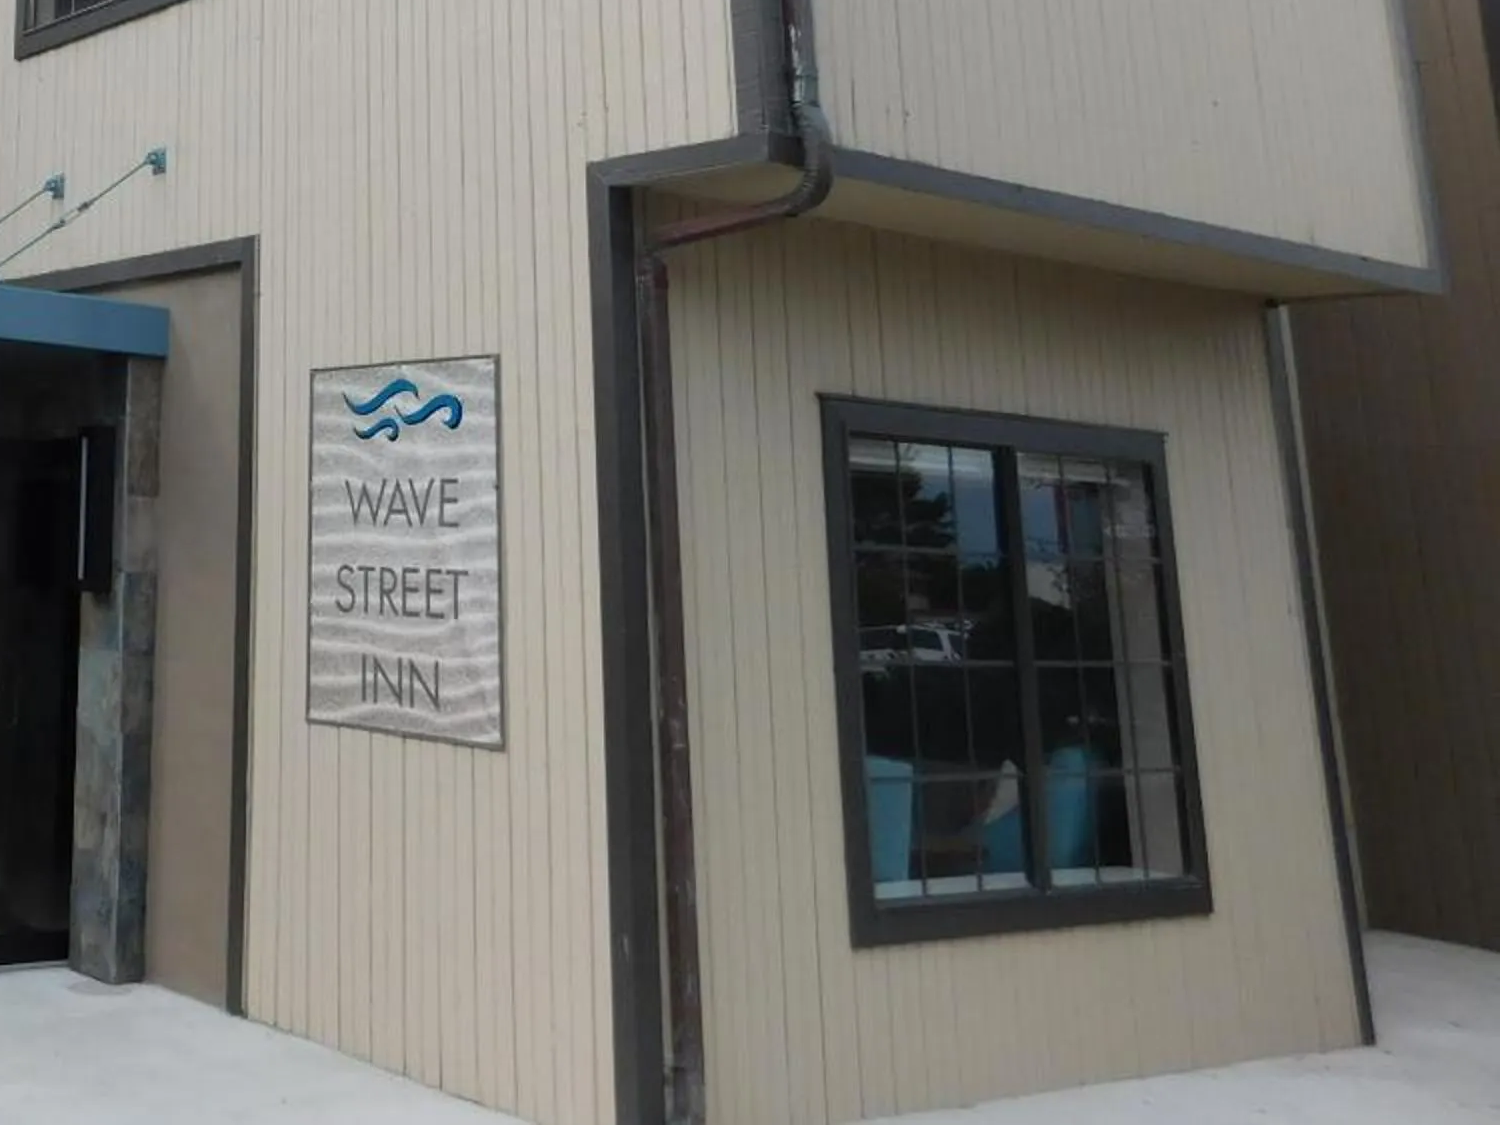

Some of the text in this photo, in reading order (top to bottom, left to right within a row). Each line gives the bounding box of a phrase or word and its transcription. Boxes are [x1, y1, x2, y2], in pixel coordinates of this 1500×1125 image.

[344, 478, 460, 528] WAVE
[335, 564, 469, 620] STREET
[361, 654, 440, 709] INN
